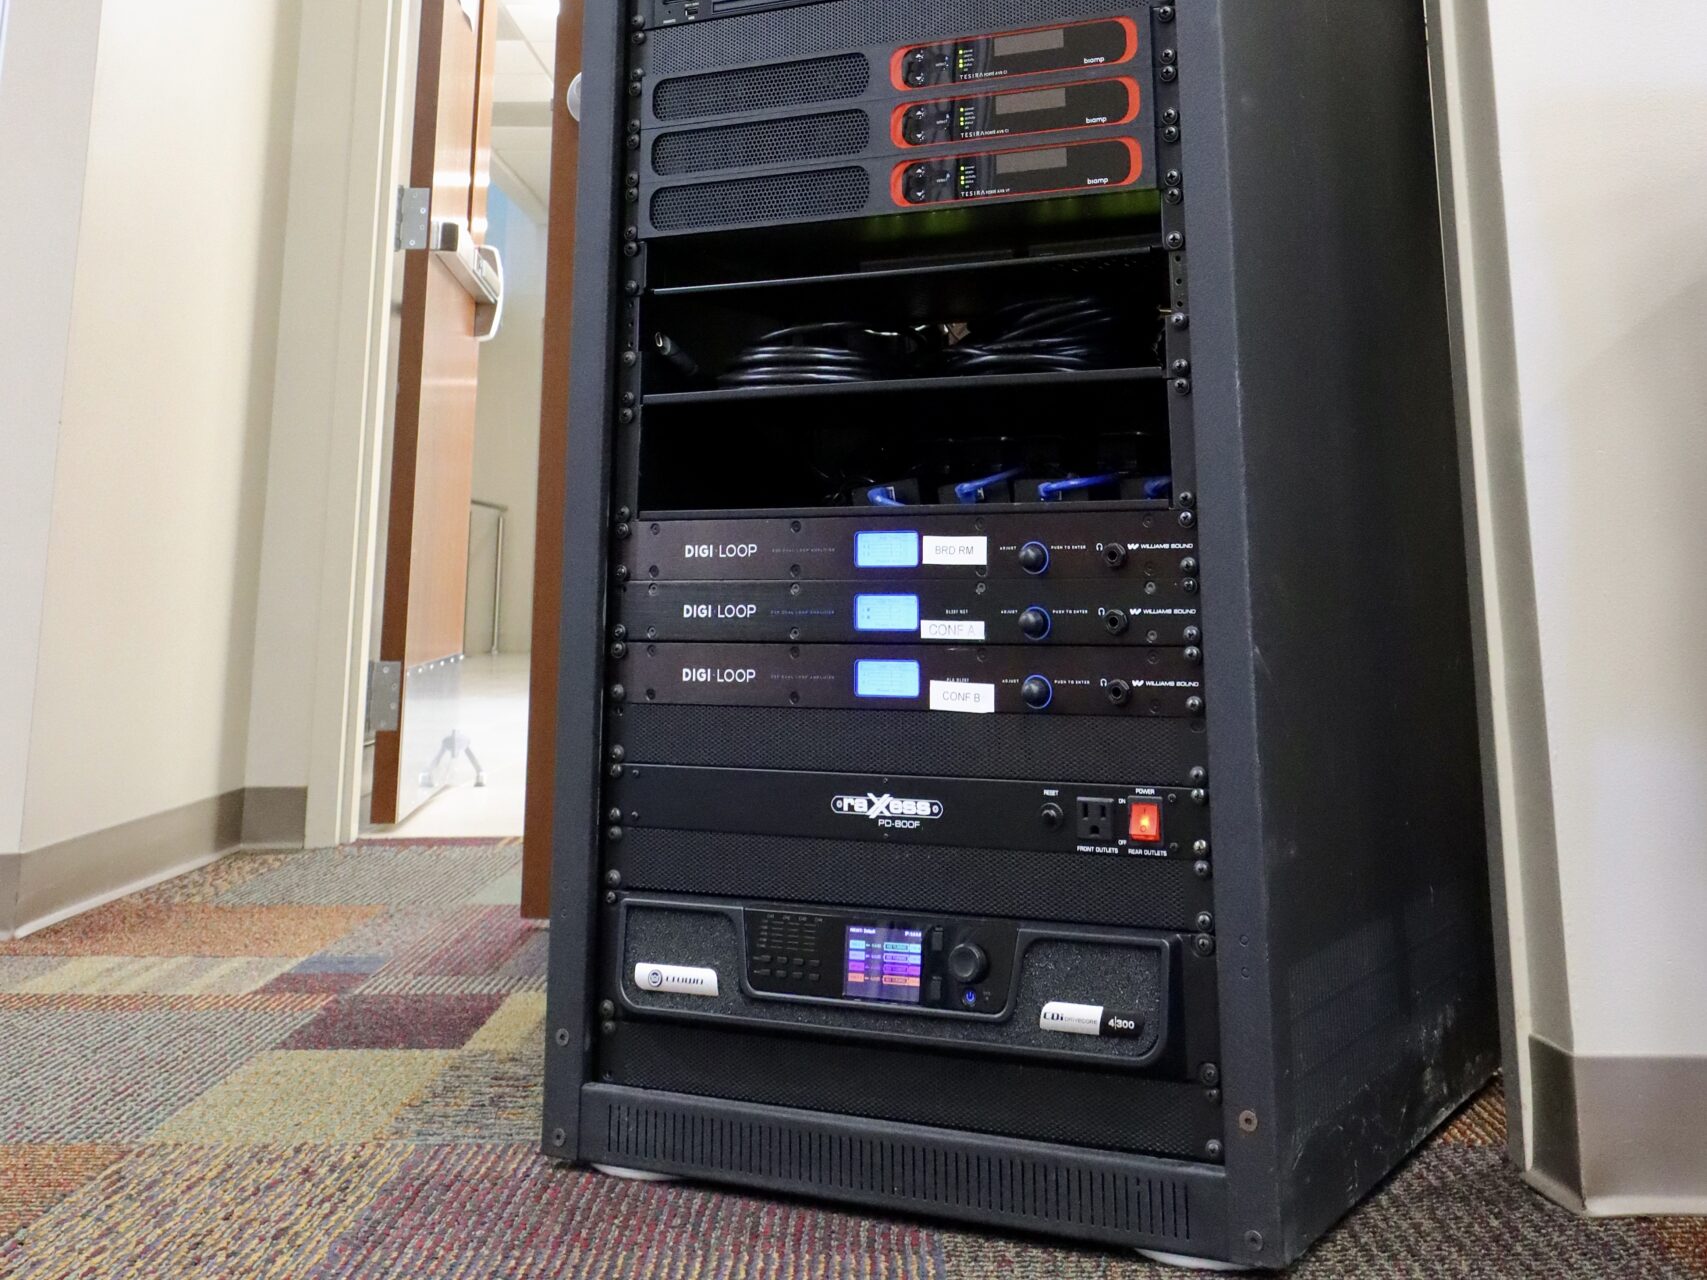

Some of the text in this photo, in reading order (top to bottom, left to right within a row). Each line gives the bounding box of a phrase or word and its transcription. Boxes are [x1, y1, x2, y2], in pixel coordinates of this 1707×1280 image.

[1084, 56, 1105, 64] biamp
[1086, 116, 1108, 124] biamp
[1087, 177, 1108, 185] biamp
[684, 544, 758, 558] DIGI LOOP
[935, 546, 974, 555] BRD RM
[683, 604, 757, 618] DIGI LOOP
[928, 624, 976, 636] CONF A
[682, 668, 756, 682] DIGI LOOP
[942, 691, 980, 702] CONF B
[878, 819, 920, 828] PD-800F
